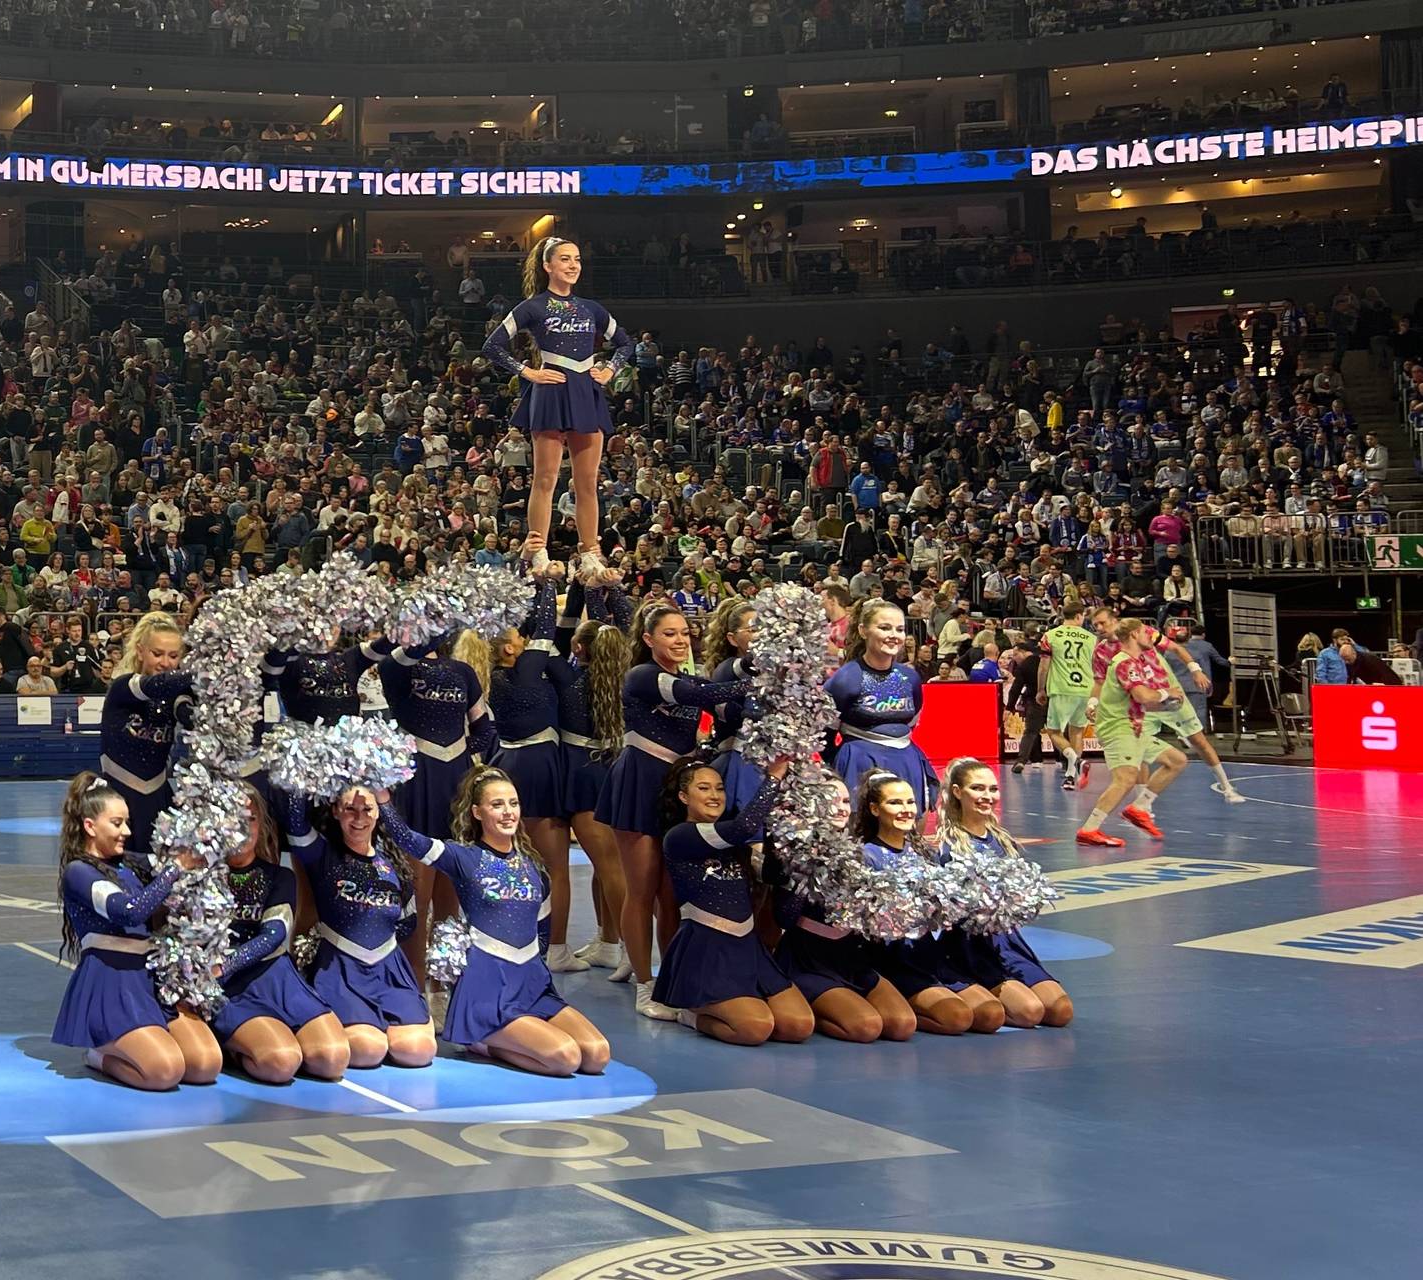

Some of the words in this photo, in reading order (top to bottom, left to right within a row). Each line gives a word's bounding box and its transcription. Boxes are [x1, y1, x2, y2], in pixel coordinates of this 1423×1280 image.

[1030, 146, 1098, 176] DAS
[1105, 131, 1265, 169] NÄCHSTE
[17, 157, 44, 183] IN
[50, 160, 263, 192] GUMMERSBACH!
[268, 169, 353, 194] JETZT
[358, 171, 454, 196] TICKET
[460, 170, 581, 195] SICHERN
[1063, 640, 1083, 659] 27
[204, 1109, 774, 1182] KÖLN
